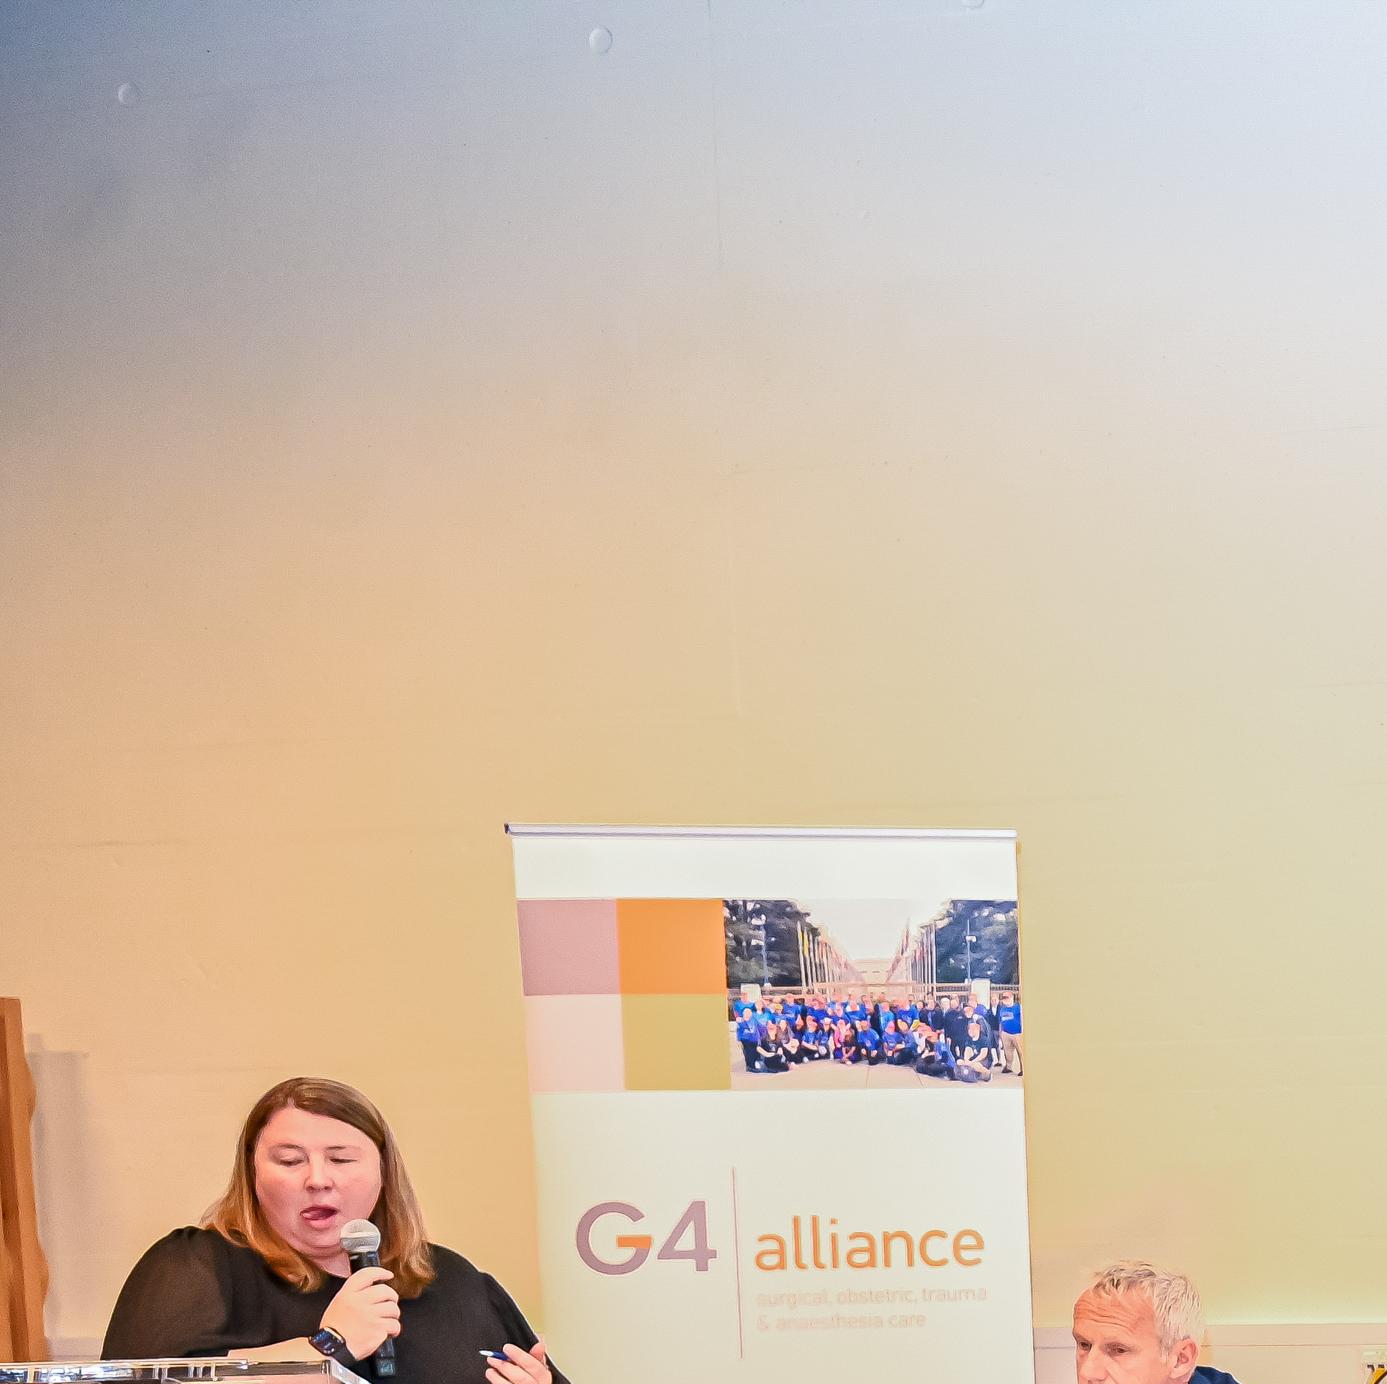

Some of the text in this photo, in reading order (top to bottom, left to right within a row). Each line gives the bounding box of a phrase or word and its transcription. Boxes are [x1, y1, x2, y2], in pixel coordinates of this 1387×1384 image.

[575, 1200, 985, 1275] G4 alliance
[922, 1287, 988, 1303] trauma
[888, 1314, 928, 1329] care
